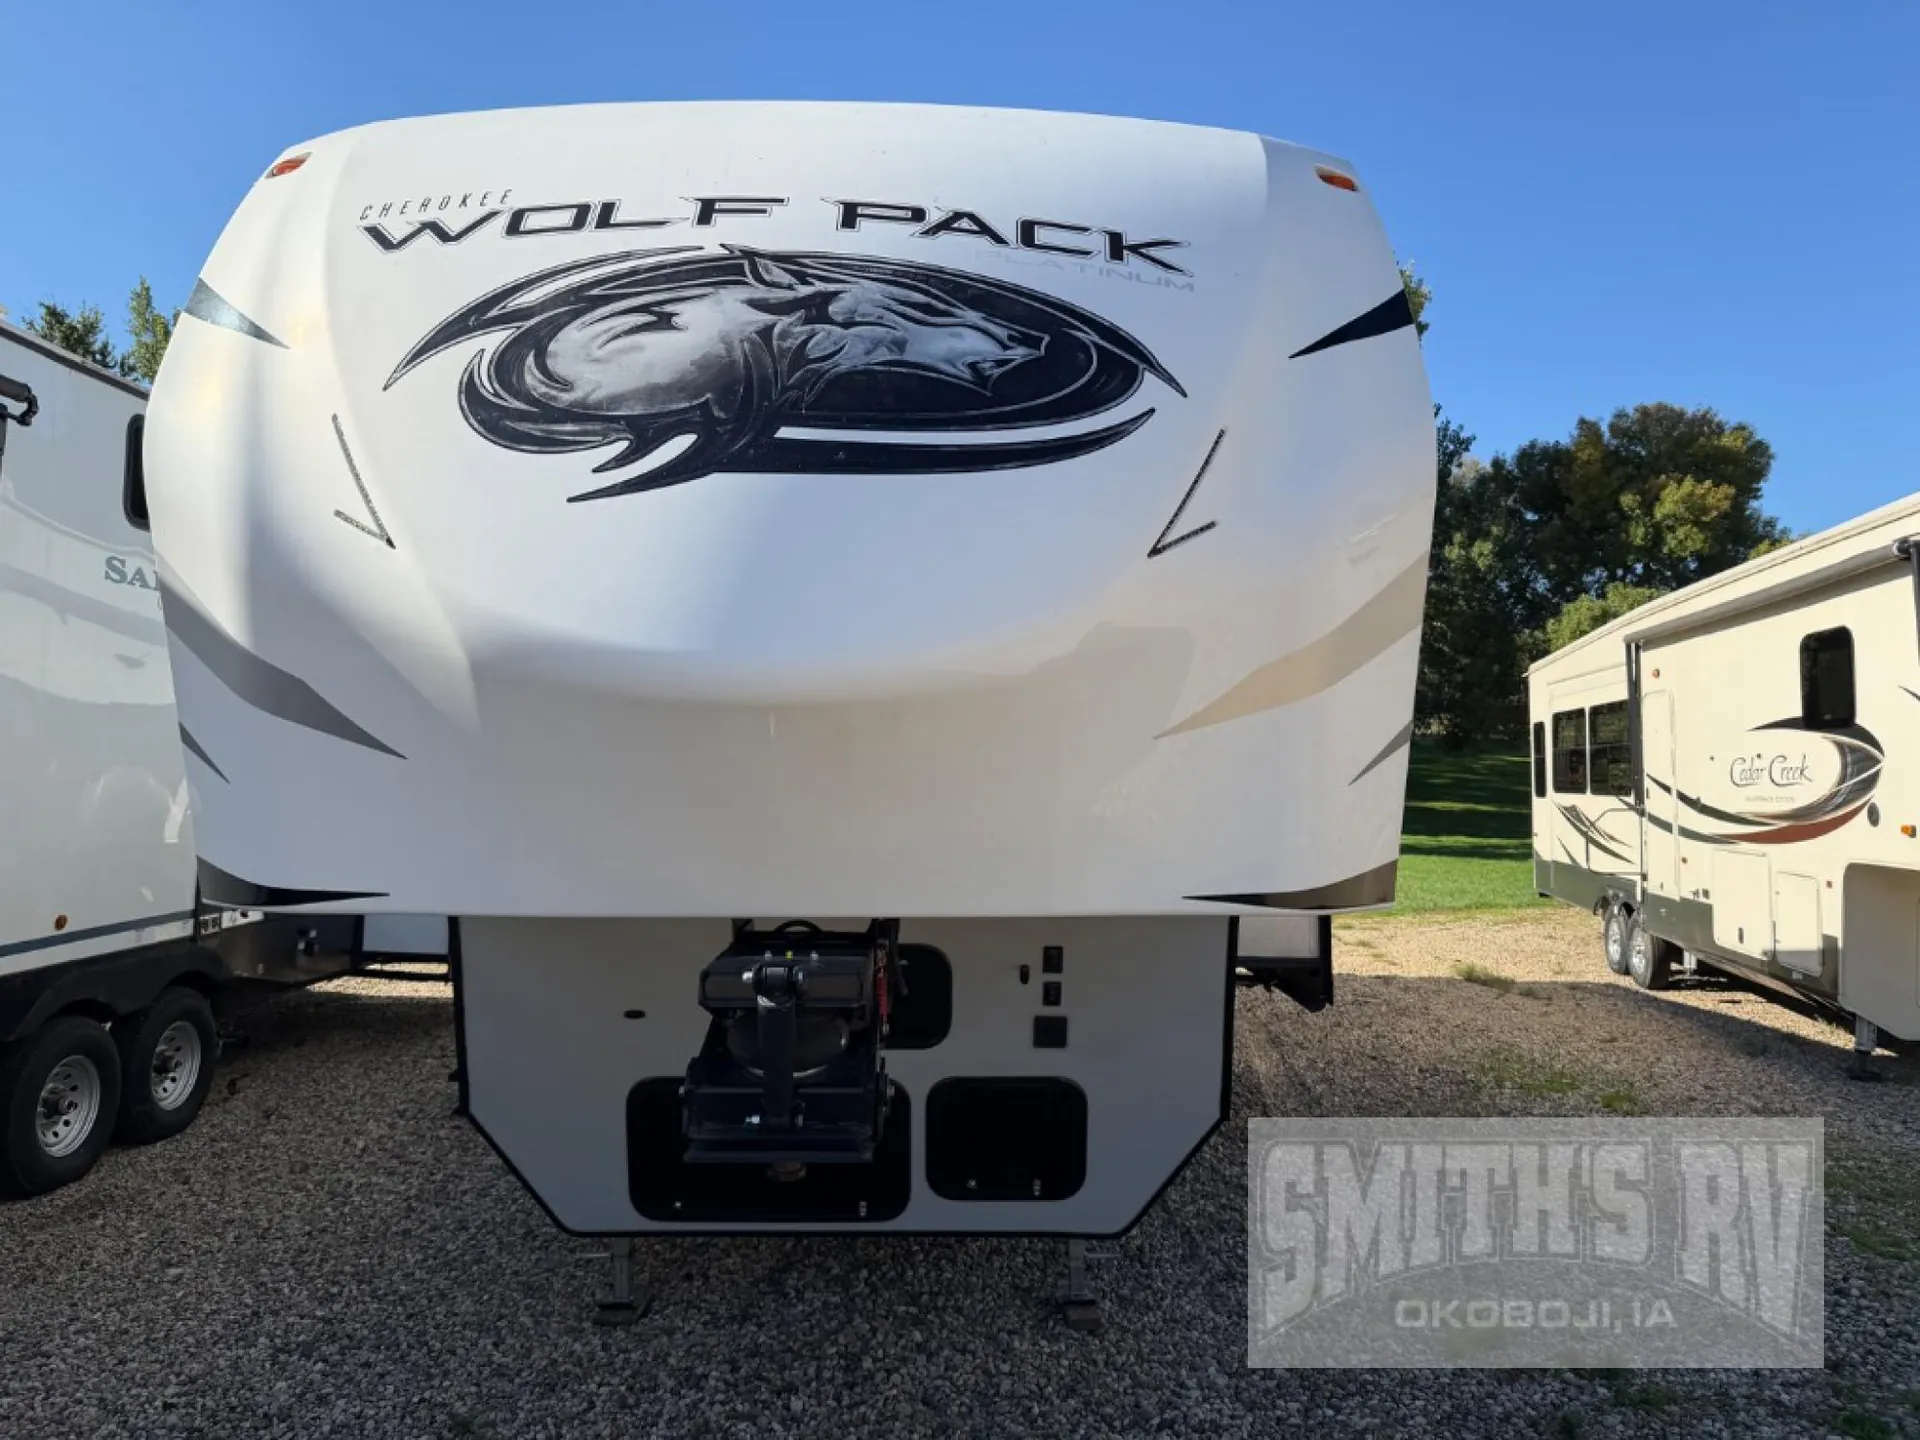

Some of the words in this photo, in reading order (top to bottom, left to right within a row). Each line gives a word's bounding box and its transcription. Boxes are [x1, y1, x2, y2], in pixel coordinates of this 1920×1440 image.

[359, 189, 513, 221] CHEROKEE
[357, 196, 790, 255] WOLF
[821, 197, 1194, 278] PACK
[974, 249, 1194, 293] PLATINUM
[1730, 755, 1767, 787] Cedar
[1769, 753, 1813, 787] Creek
